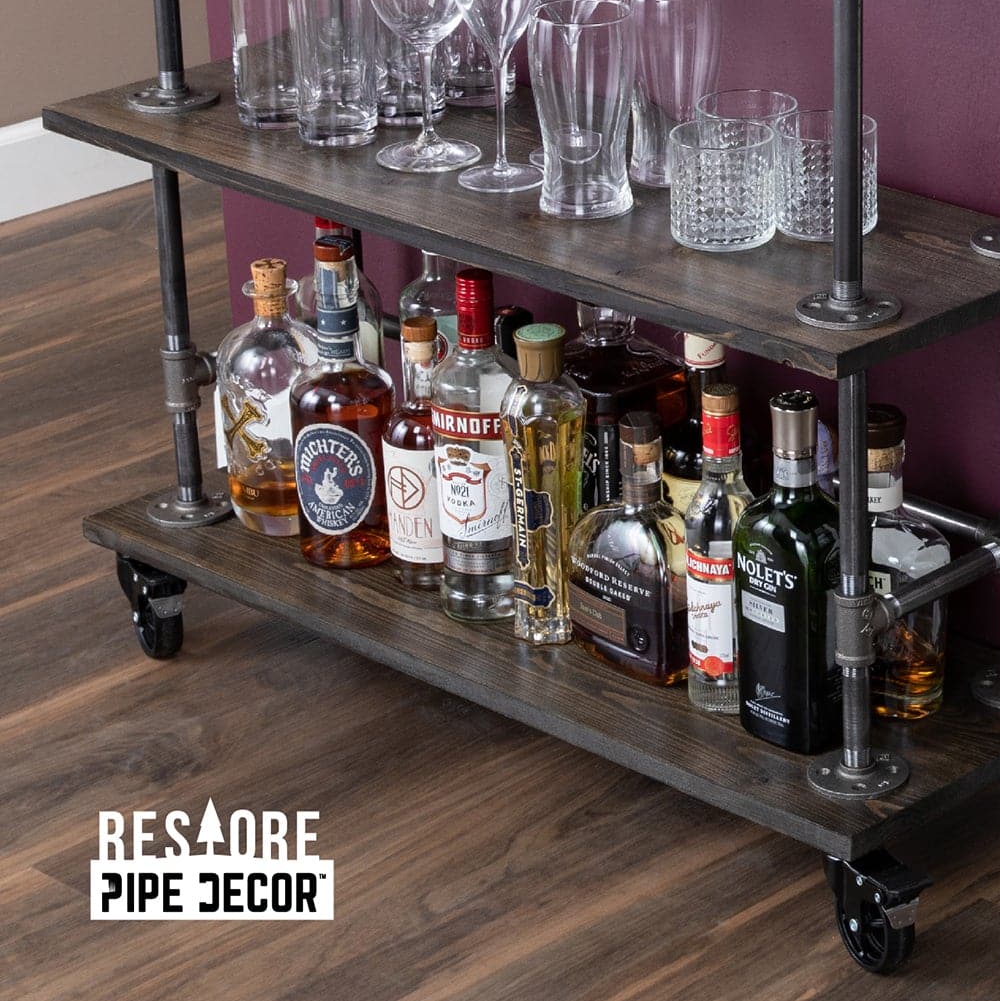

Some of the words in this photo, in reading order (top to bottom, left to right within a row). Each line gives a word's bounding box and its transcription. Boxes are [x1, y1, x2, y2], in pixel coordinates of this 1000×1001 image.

[431, 407, 501, 434] MIRNOFF
[307, 501, 356, 520] AMERICAN
[447, 497, 476, 507] VODKA
[571, 554, 610, 582] WOODFORD
[611, 576, 651, 598] RESERVE
[687, 556, 730, 576] LICHNAYA
[736, 551, 795, 590] NOLET'S
[749, 576, 763, 588] DRY
[763, 582, 777, 594] GIN
